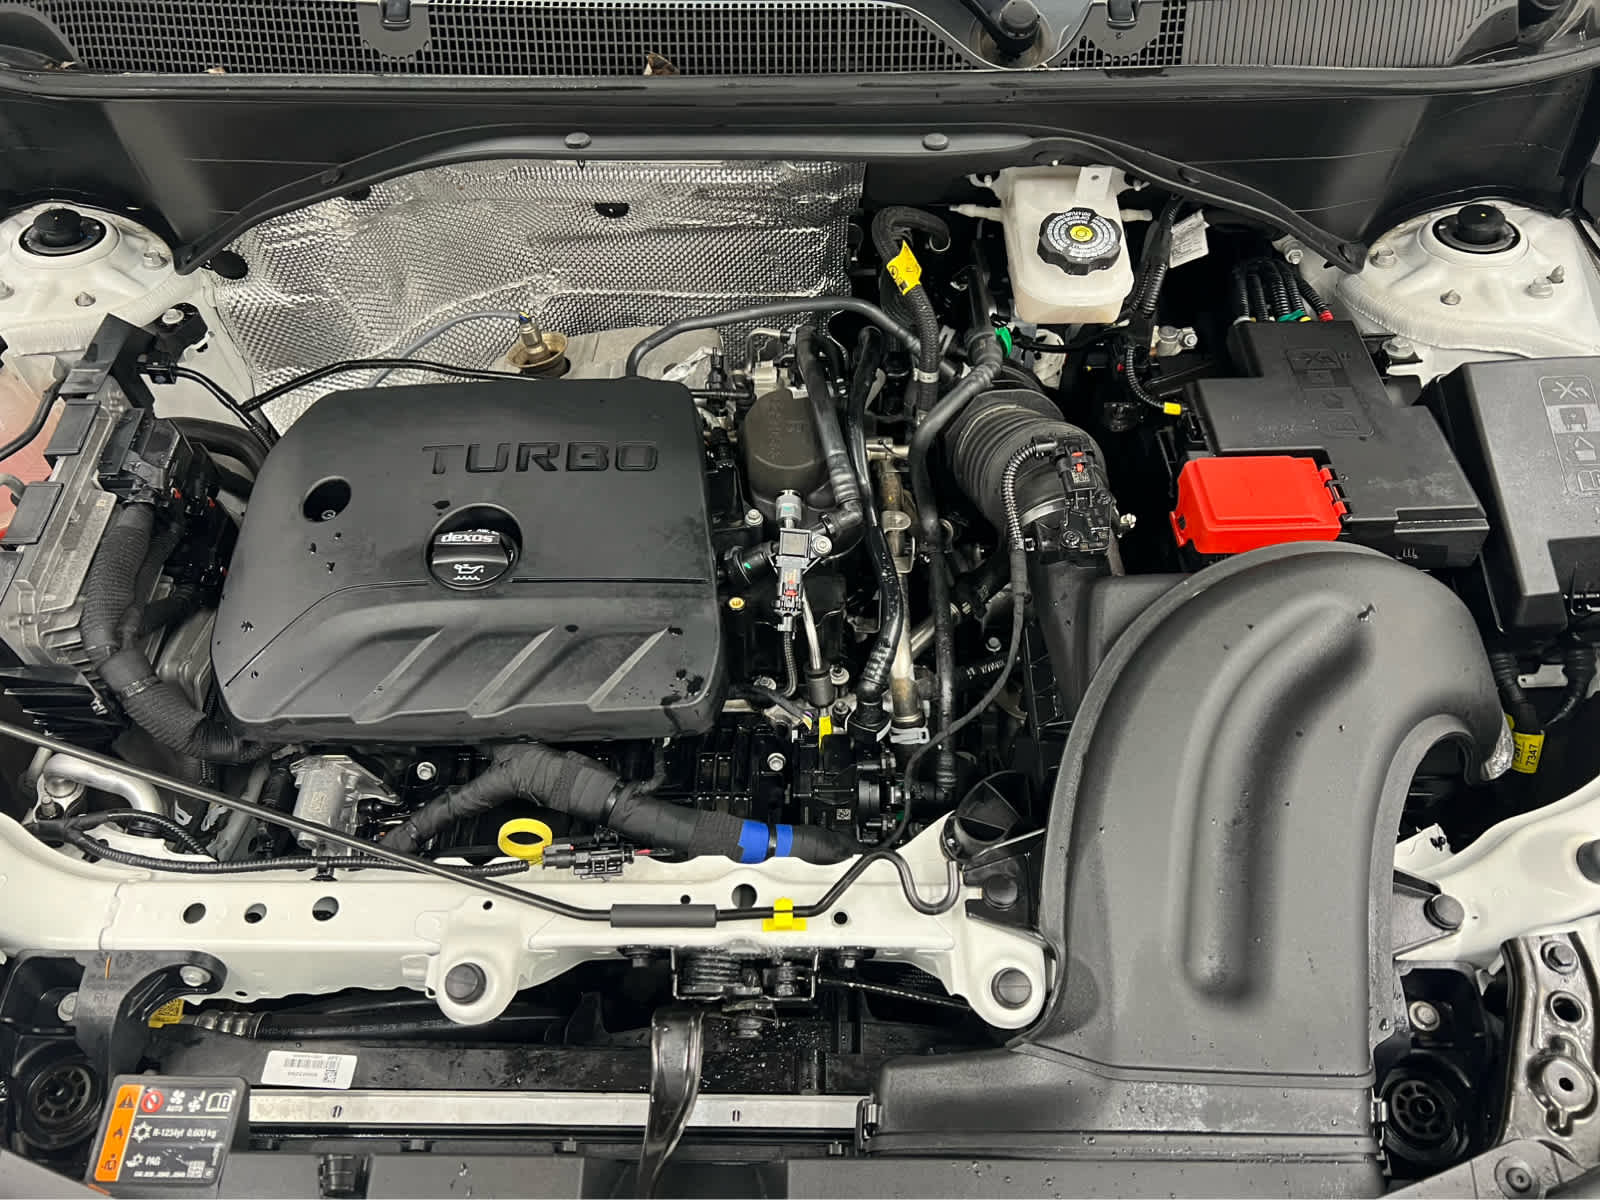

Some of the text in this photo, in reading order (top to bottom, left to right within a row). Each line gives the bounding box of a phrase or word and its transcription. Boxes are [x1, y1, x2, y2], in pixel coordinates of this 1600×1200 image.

[422, 441, 659, 475] TURBO
[441, 532, 496, 543] dexos
[1526, 743, 1538, 767] 7347
[207, 1127, 217, 1139] kg
